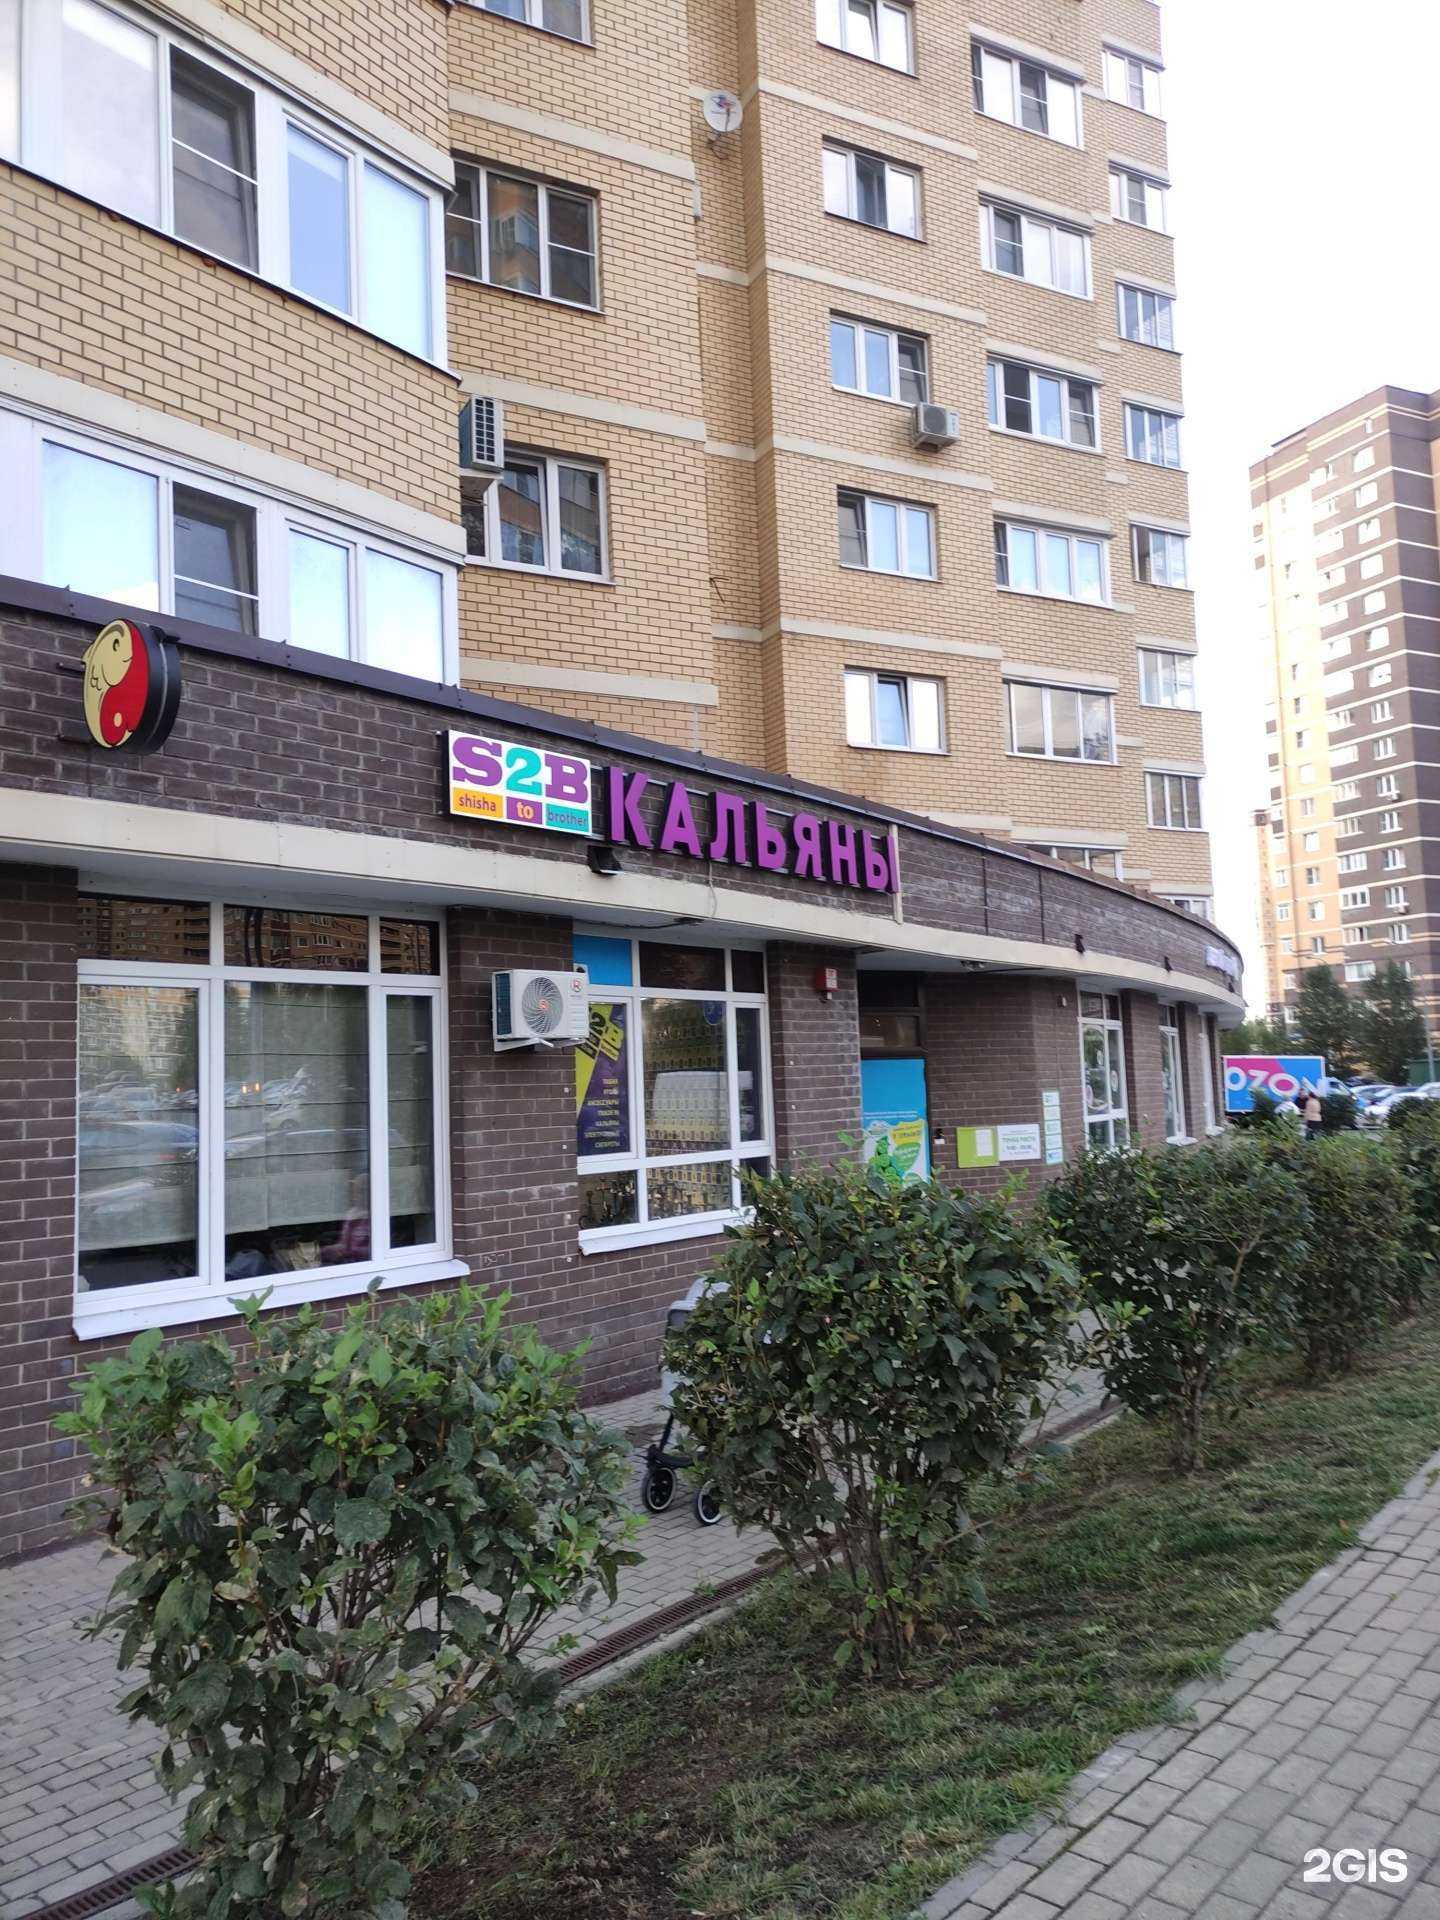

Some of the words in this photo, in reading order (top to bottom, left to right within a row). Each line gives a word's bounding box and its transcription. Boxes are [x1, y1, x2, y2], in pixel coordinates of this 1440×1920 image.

[452, 736, 589, 804] S2B
[458, 793, 497, 812] shisha
[516, 801, 535, 820] to
[547, 811, 589, 827] brother
[606, 767, 898, 893] КАЛЬЯНЫ
